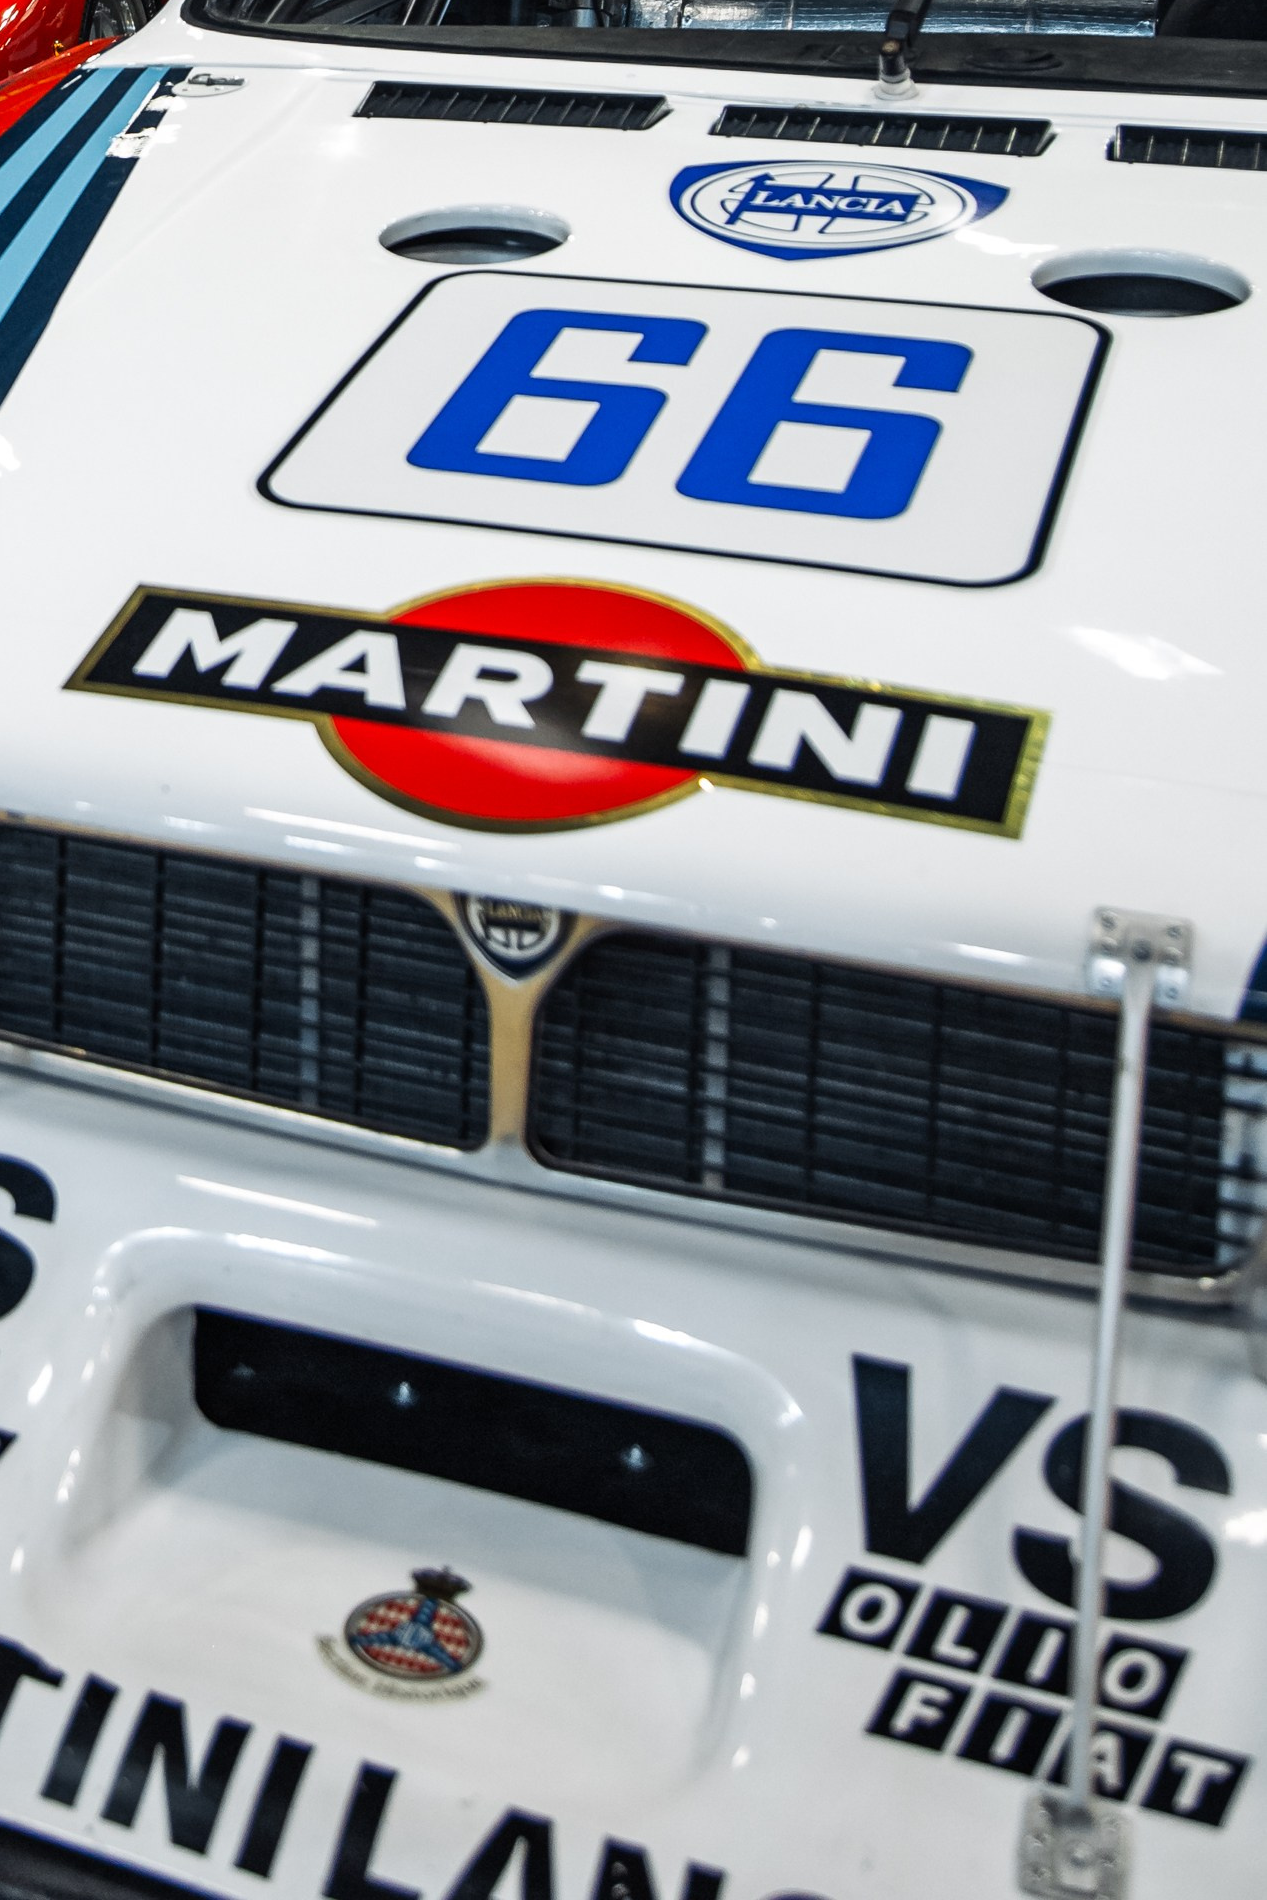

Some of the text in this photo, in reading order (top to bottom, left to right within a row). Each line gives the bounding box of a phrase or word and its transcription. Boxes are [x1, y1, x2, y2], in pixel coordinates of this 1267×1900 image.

[749, 189, 908, 216] LANCIA
[406, 308, 975, 520] 66
[132, 606, 976, 801] MARTINI
[851, 1352, 1232, 1623] VS
[835, 1579, 1169, 1703] OLIO
[887, 1678, 1236, 1816] FIAT
